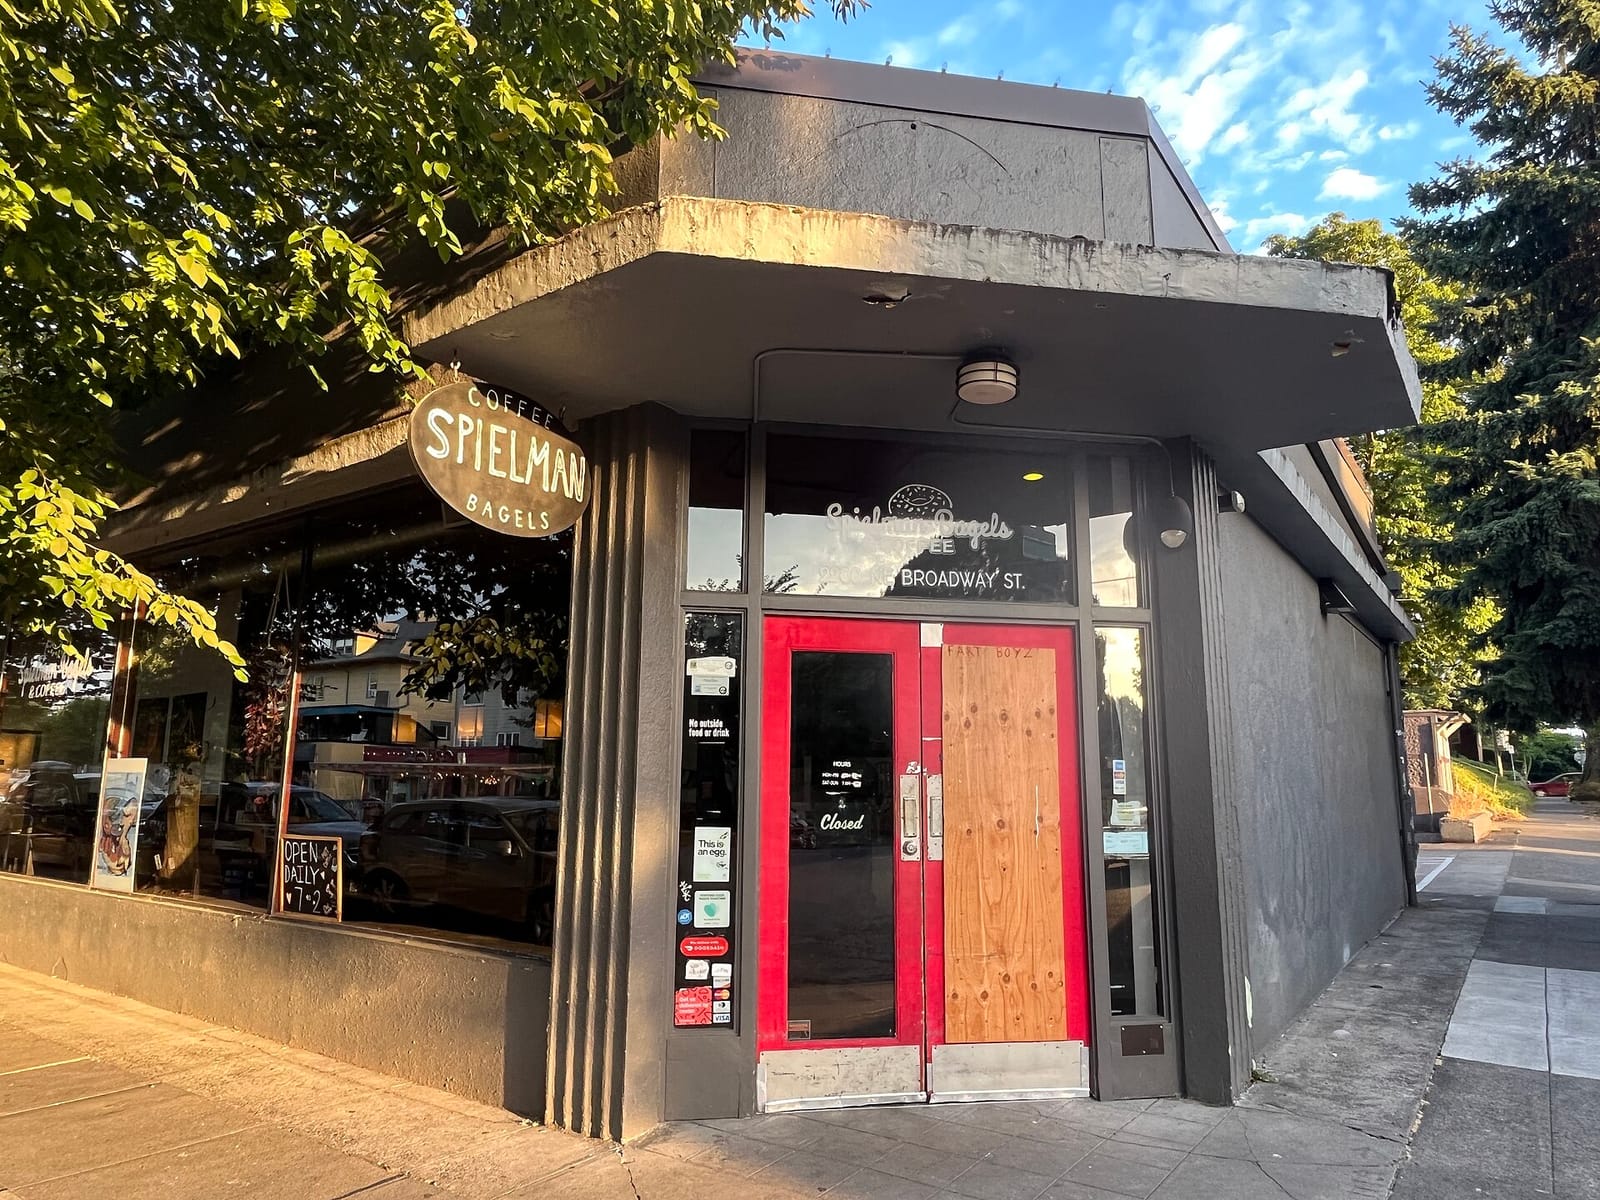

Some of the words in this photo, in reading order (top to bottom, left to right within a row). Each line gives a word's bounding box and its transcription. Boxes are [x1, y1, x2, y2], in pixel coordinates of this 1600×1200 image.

[467, 386, 554, 430] COFFEE
[425, 407, 587, 503] SPIELMAN
[465, 493, 551, 530] BAGELS
[900, 568, 996, 590] BROADWAY
[1003, 572, 1026, 590] ST.
[947, 645, 981, 657] FART
[996, 647, 1033, 659] BOYZ
[688, 718, 698, 728] No
[699, 718, 724, 728] outside
[688, 728, 703, 738] food
[704, 729, 712, 737] or
[712, 728, 730, 738] drink
[819, 812, 865, 831] Closed
[284, 840, 319, 864] OPEN
[698, 839, 716, 848] This
[716, 839, 725, 848] is
[709, 849, 727, 858] egg.
[284, 864, 320, 886] DAILY
